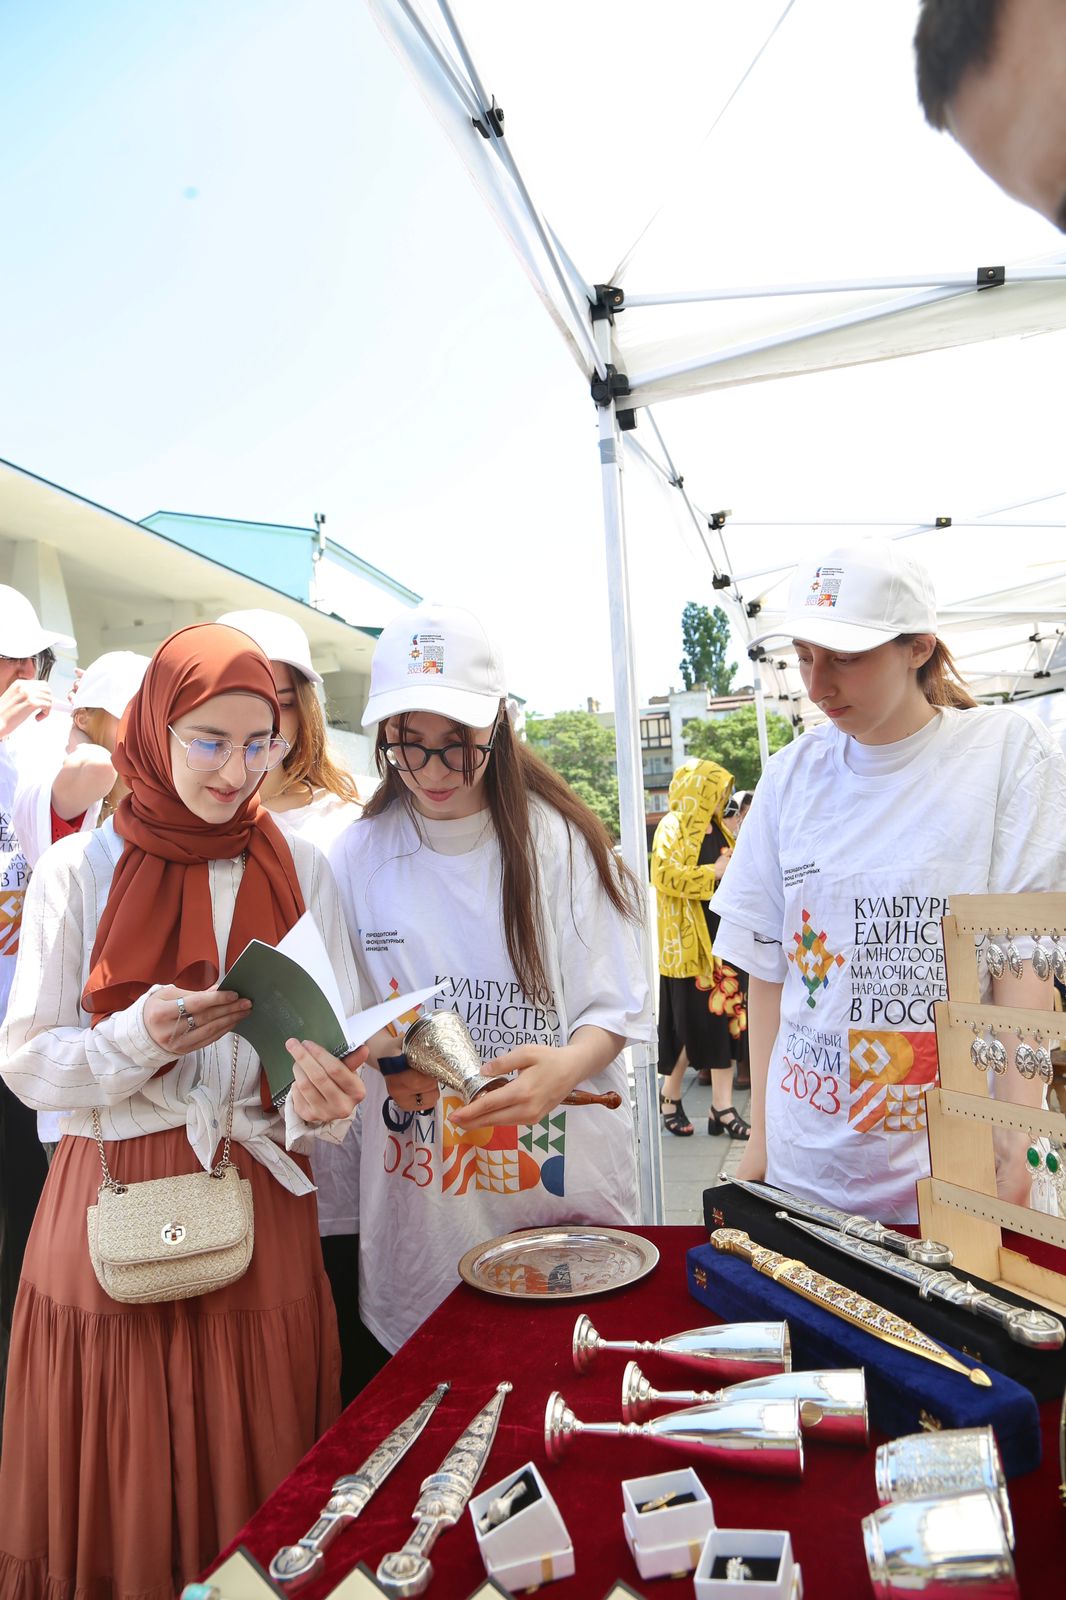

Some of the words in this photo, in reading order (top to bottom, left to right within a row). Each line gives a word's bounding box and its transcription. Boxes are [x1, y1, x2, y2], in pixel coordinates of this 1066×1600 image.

[855, 920, 942, 946] ЕДИНС
[852, 948, 861, 962] И
[866, 947, 944, 963] МНОГООБ
[850, 965, 944, 981] МАЛОЧИСЛЕ
[851, 983, 909, 997] НАРОДОВ
[911, 984, 949, 997] ДАГЕ
[850, 998, 863, 1022] В
[871, 998, 944, 1025] РОСС
[466, 1027, 561, 1048] ОГООБРАЗИЕ
[786, 1033, 842, 1076] ФОРУМ
[780, 1056, 841, 1115] 2023
[383, 1135, 434, 1188] 023
